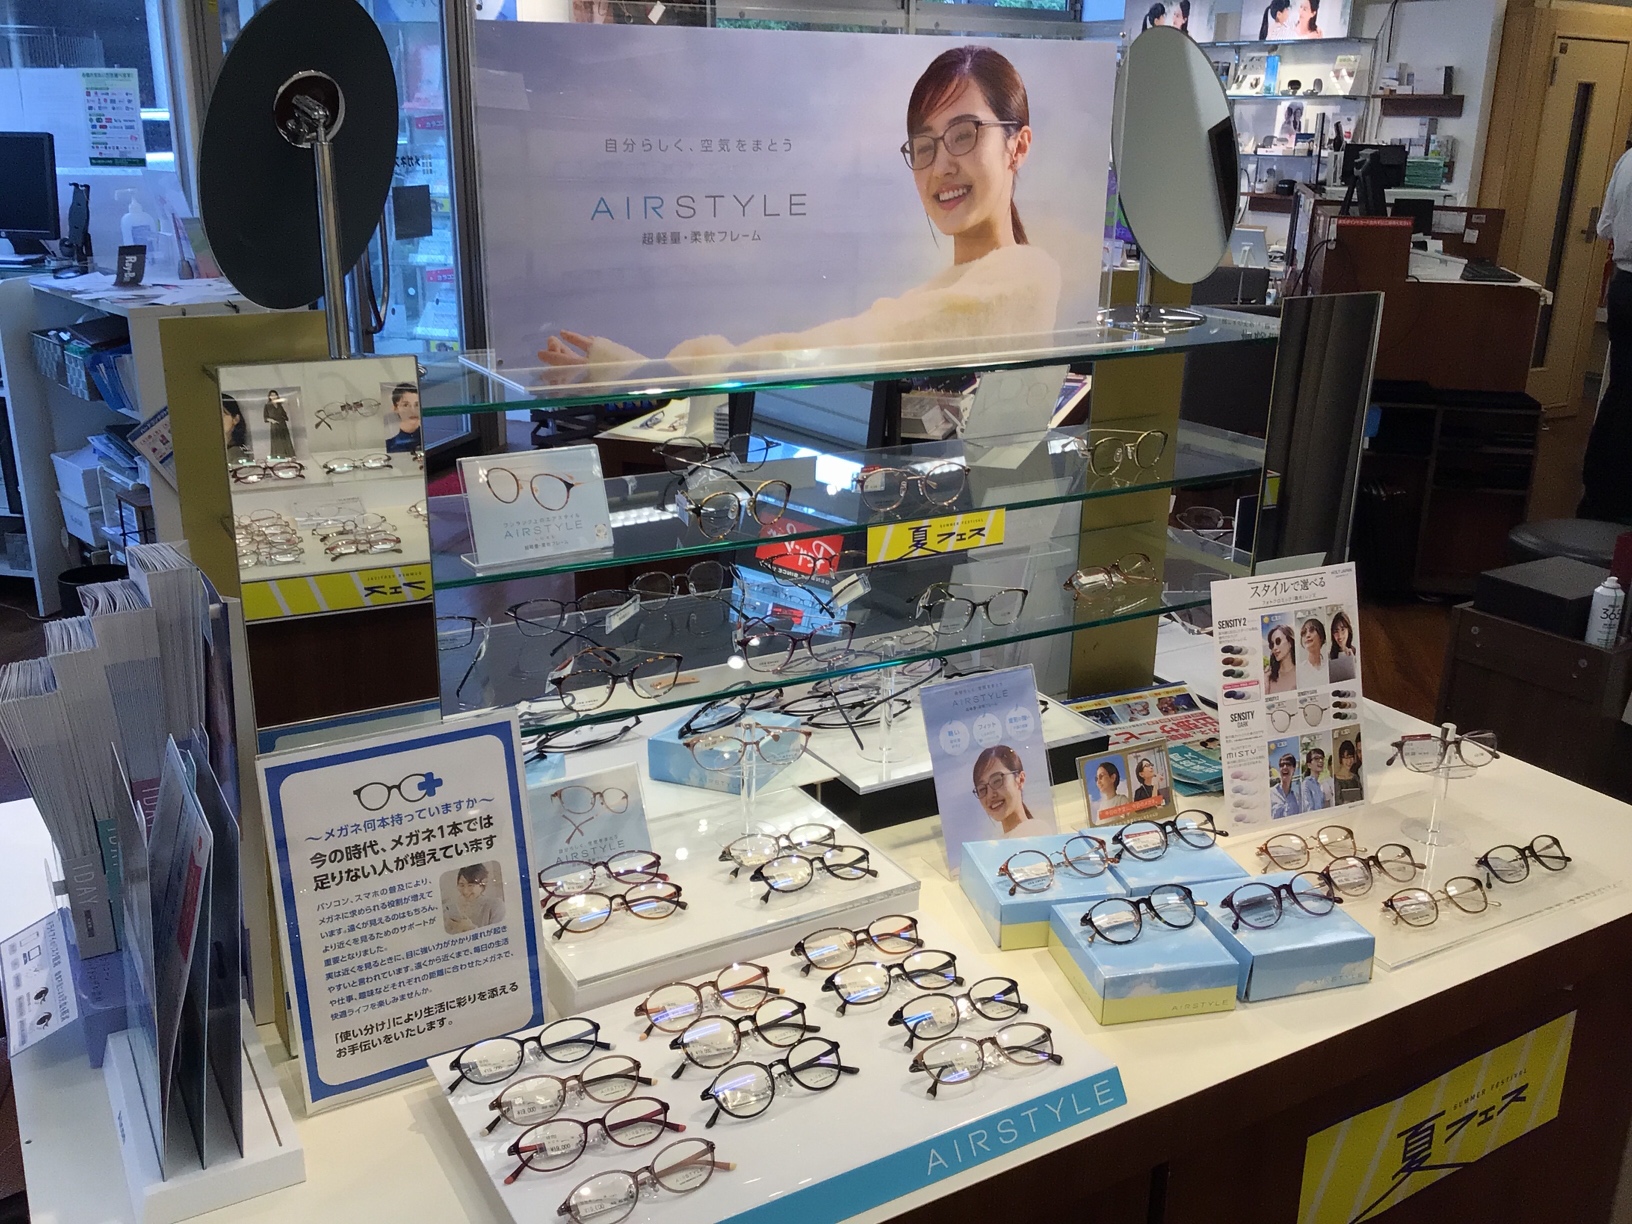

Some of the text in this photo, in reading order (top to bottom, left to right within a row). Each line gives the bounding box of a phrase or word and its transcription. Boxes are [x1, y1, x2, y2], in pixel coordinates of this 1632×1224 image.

[604, 138, 793, 153] 自分らしく、空気をまとう
[590, 193, 808, 221] AIRSTYLE
[641, 230, 762, 246] 超軽量・柔軟フレーム
[504, 519, 584, 540] AIRSTYLE
[902, 524, 987, 558] 夏フェス
[1250, 576, 1326, 599] スタイルで選べる
[1217, 617, 1247, 630] SENSITY 2
[951, 689, 1009, 707] AIRSTYLE
[1229, 710, 1255, 723] SENSITY
[309, 814, 495, 869] 今の時代、メガネ1本では
[555, 839, 626, 864] AIRSTYLE
[313, 834, 498, 892] 足りない人が増えています
[72, 862, 98, 906] 1DAY
[317, 879, 433, 912] パソコン、スマホの普及により、
[318, 890, 434, 925] メガネに求められる役割が増えて
[320, 905, 439, 940] います。遠くが見えるのはもちろん、
[322, 916, 437, 954] より近くを見るためのサポートが
[325, 924, 508, 981] 実は近くを見るときに、目に強い力がかかり疲れが起き
[324, 945, 389, 968] 重要となりました。
[327, 936, 510, 993] やすいと言われています。遠くから近くまで、毎日の生活
[329, 950, 514, 1008] や仕事、趣味などそれぞれの距離に合わせたメガネで、
[330, 987, 433, 1022] 快適ライフを楽しみませんか。
[335, 981, 519, 1045] 「使い分け」により生活に彩りを添える
[1170, 999, 1229, 1011] AIRSTYLE
[336, 1017, 454, 1059] お手伝いをいたします。
[1453, 1067, 1528, 1112] SUMMER FESTIVAL
[926, 1079, 1115, 1176] AIRSTYLE
[1384, 1083, 1529, 1195] 夏フェス
